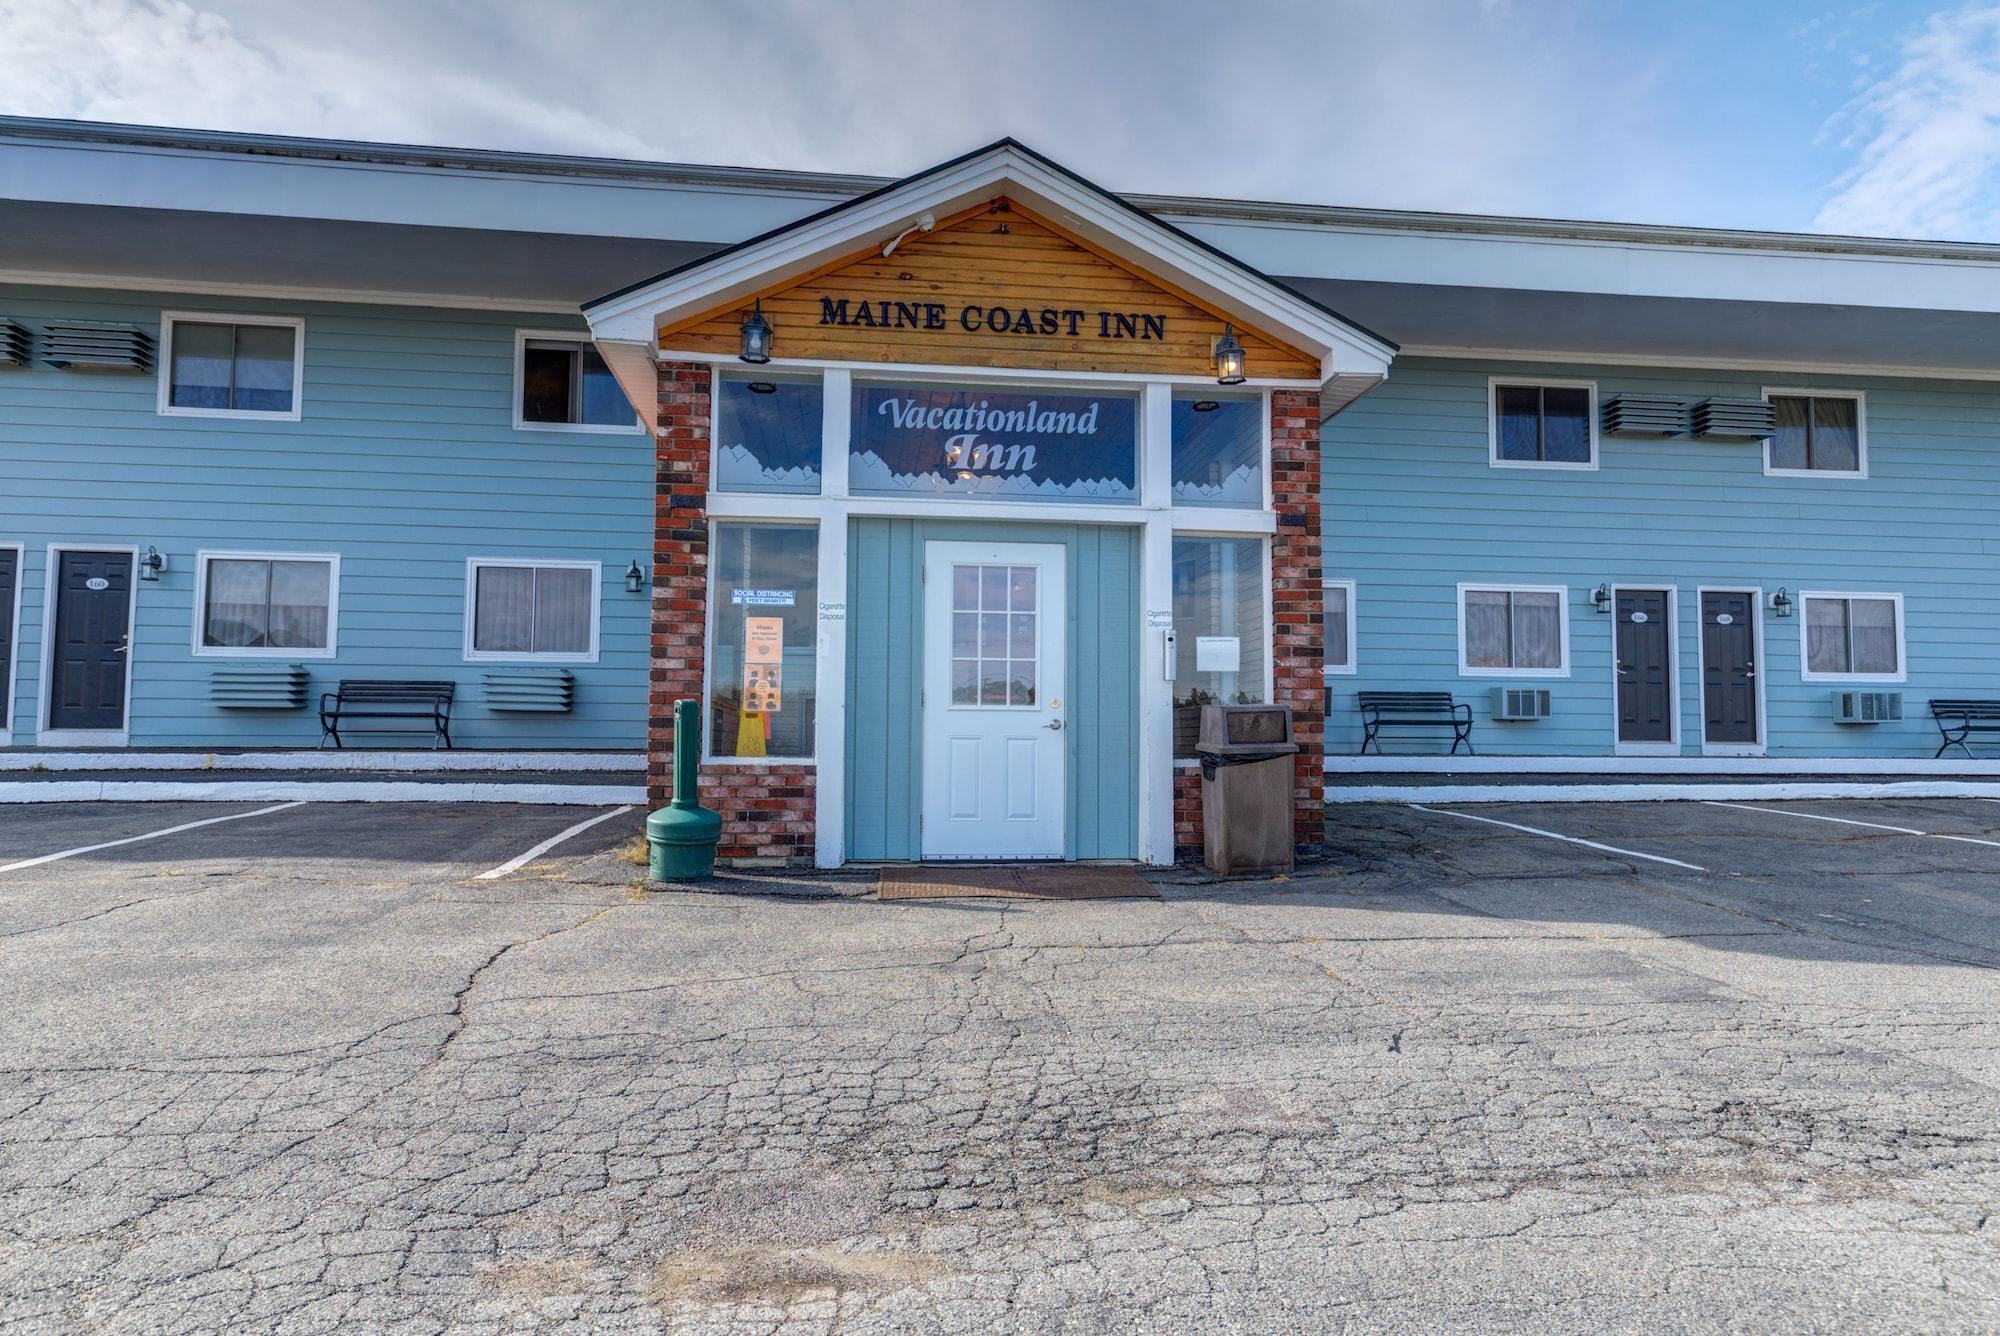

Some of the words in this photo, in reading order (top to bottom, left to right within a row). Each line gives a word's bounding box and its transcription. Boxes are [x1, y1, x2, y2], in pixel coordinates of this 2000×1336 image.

[819, 297, 946, 329] MAINE
[960, 306, 1085, 336] COAST
[1098, 312, 1167, 340] INN
[878, 398, 1099, 434] Vacationland
[944, 433, 1038, 471] Inn
[733, 589, 756, 598] SOCIAL
[757, 590, 793, 599] DISTANCING
[819, 602, 846, 611] Cigarette
[819, 612, 845, 621] Disposal
